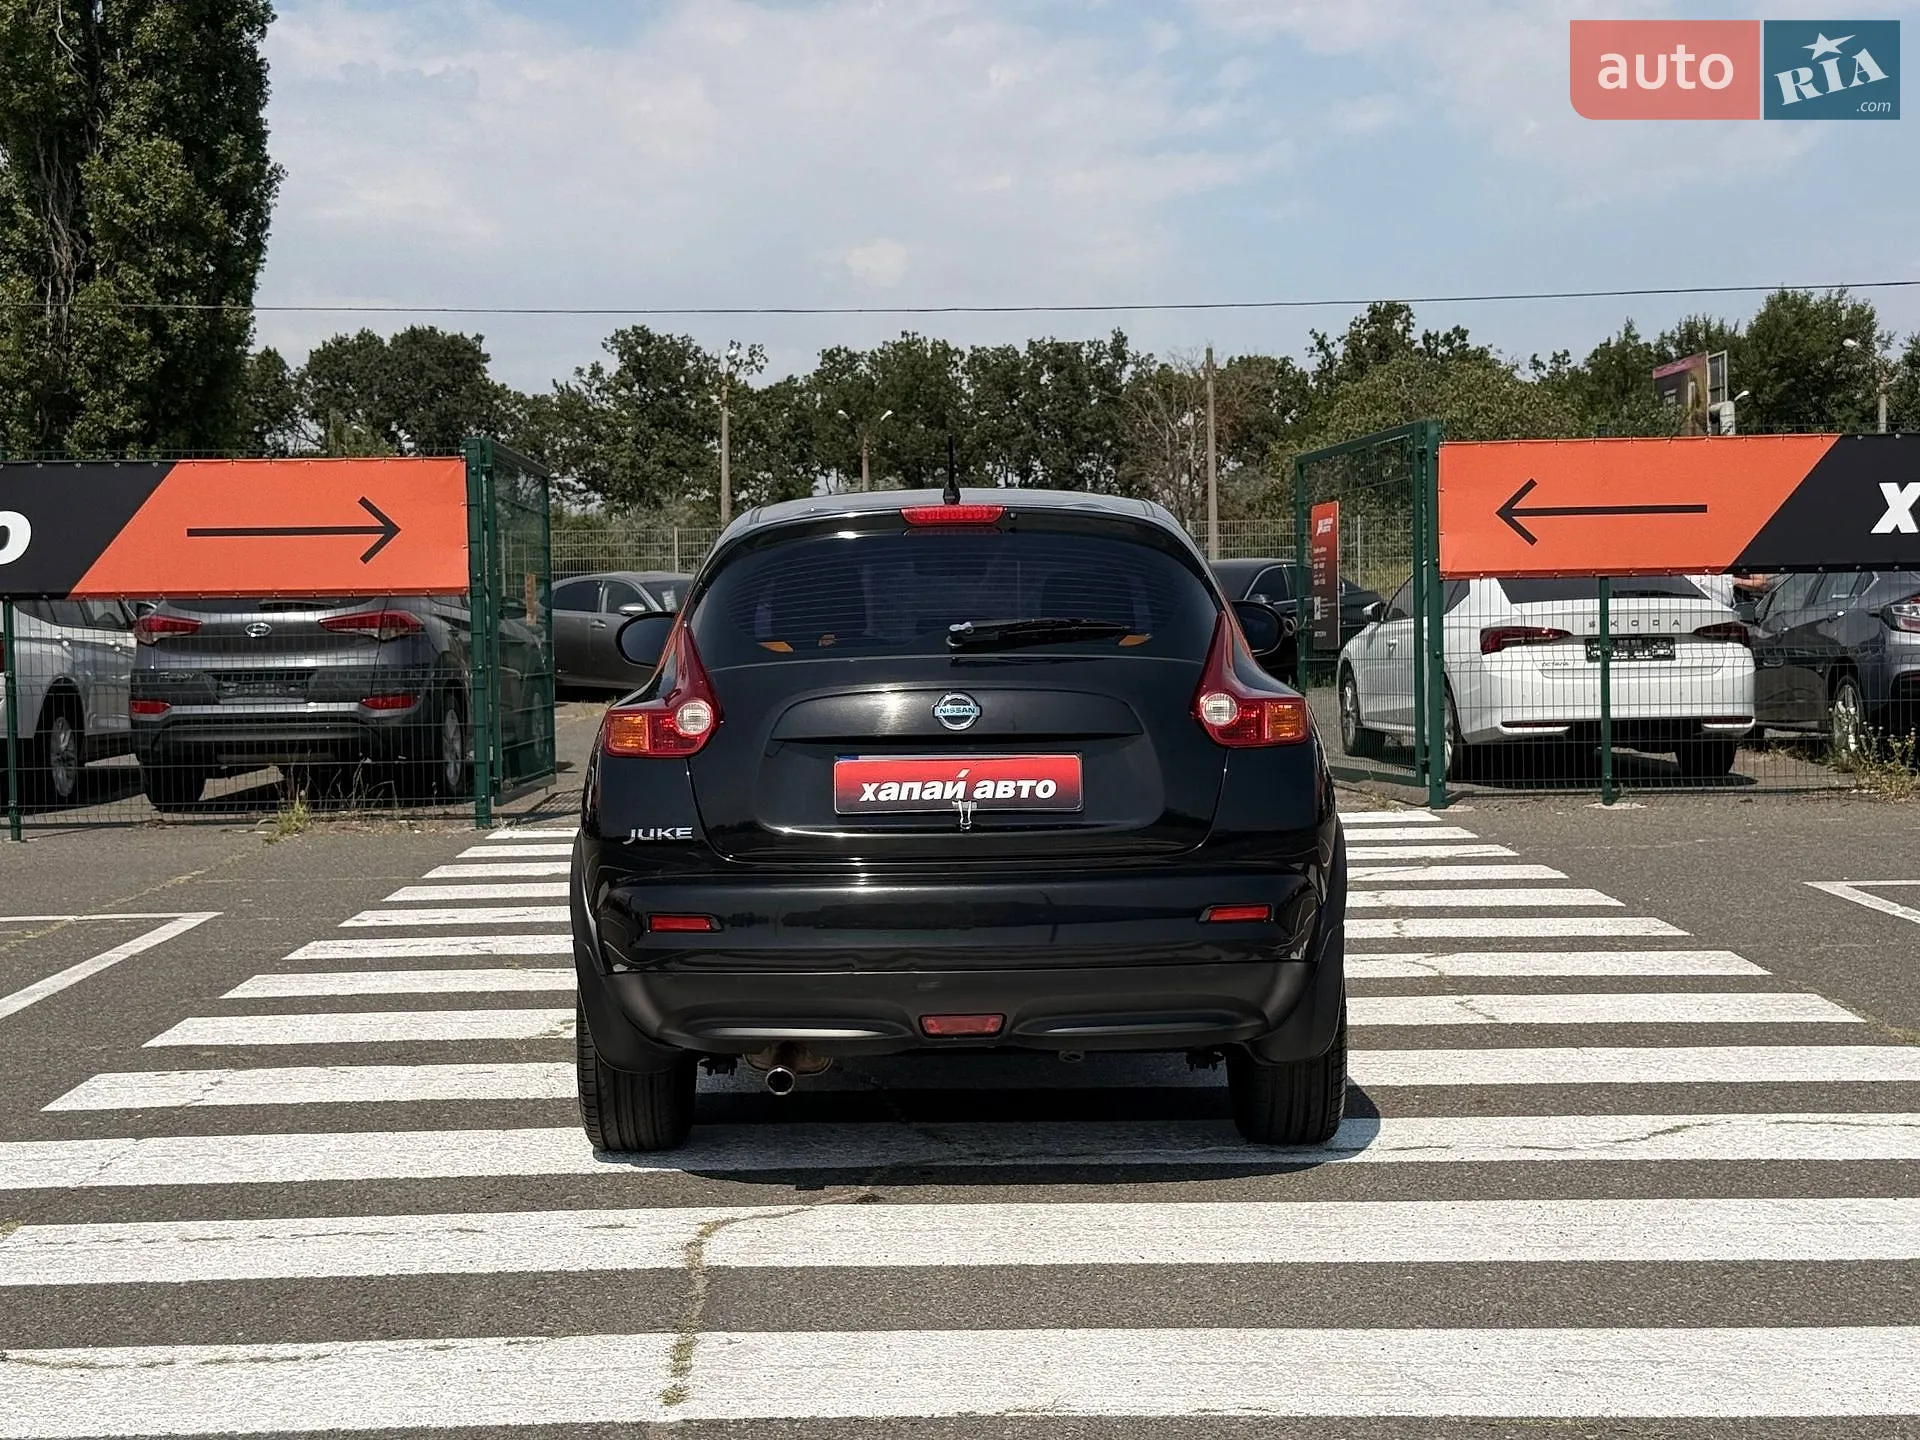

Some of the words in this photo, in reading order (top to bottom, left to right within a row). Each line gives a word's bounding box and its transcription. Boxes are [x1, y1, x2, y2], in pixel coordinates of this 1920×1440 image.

[939, 706, 976, 714] NISSAN
[859, 768, 971, 802] хапай
[972, 778, 1057, 800] авто
[621, 826, 694, 845] JUKE
